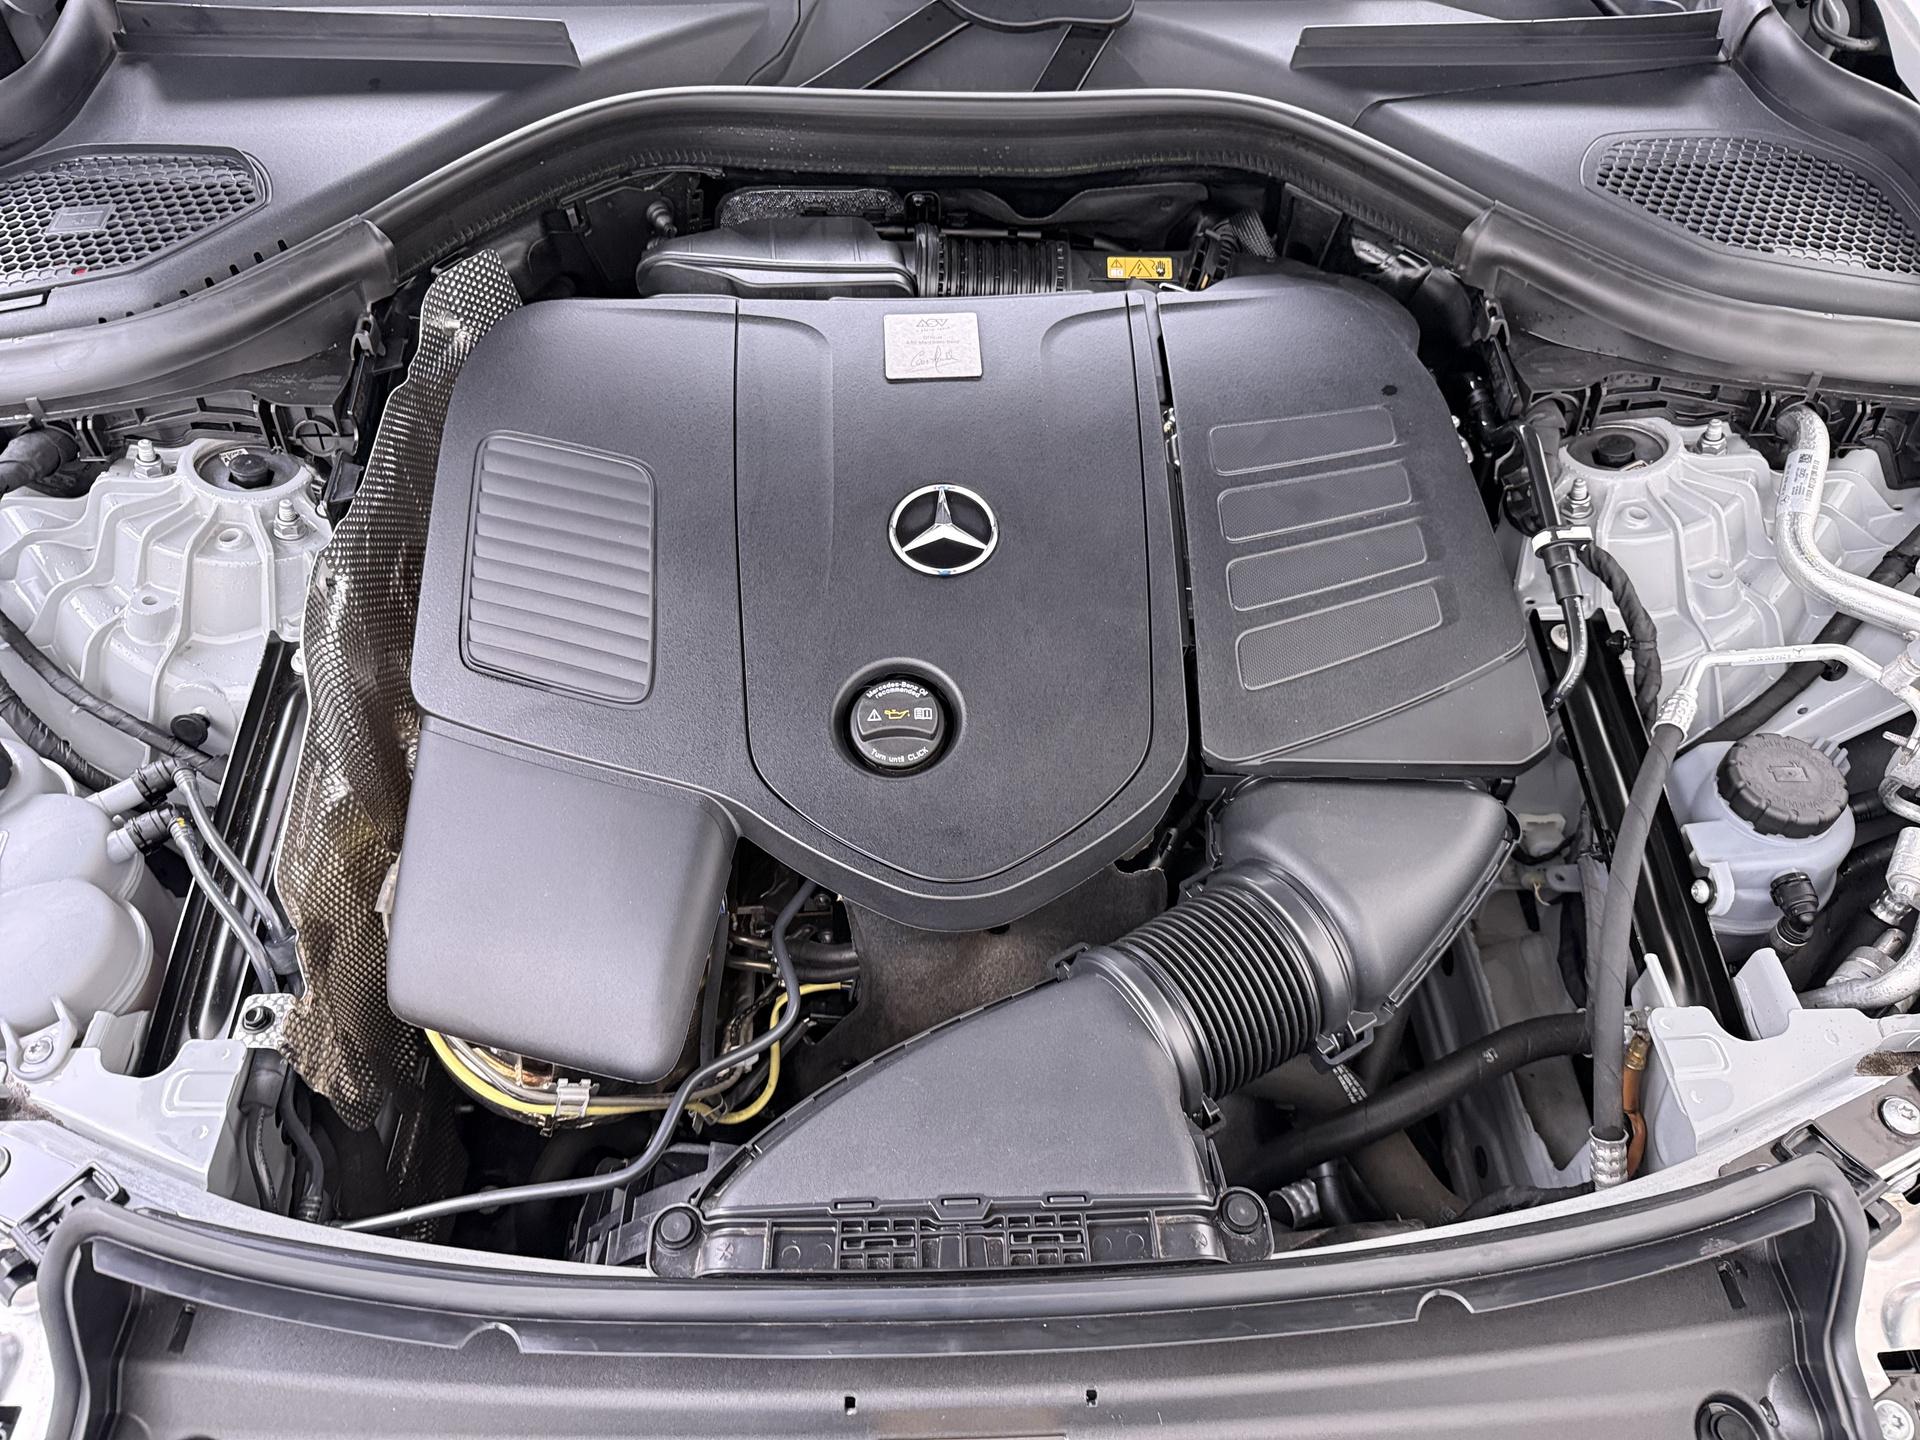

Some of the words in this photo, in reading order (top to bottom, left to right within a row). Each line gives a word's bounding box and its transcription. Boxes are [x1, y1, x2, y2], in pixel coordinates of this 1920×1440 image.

[866, 681, 918, 698] Mercedes-Benz
[875, 687, 921, 699] recommended
[870, 748, 887, 761] Turn
[888, 755, 905, 763] until
[907, 747, 929, 761] CLICK
